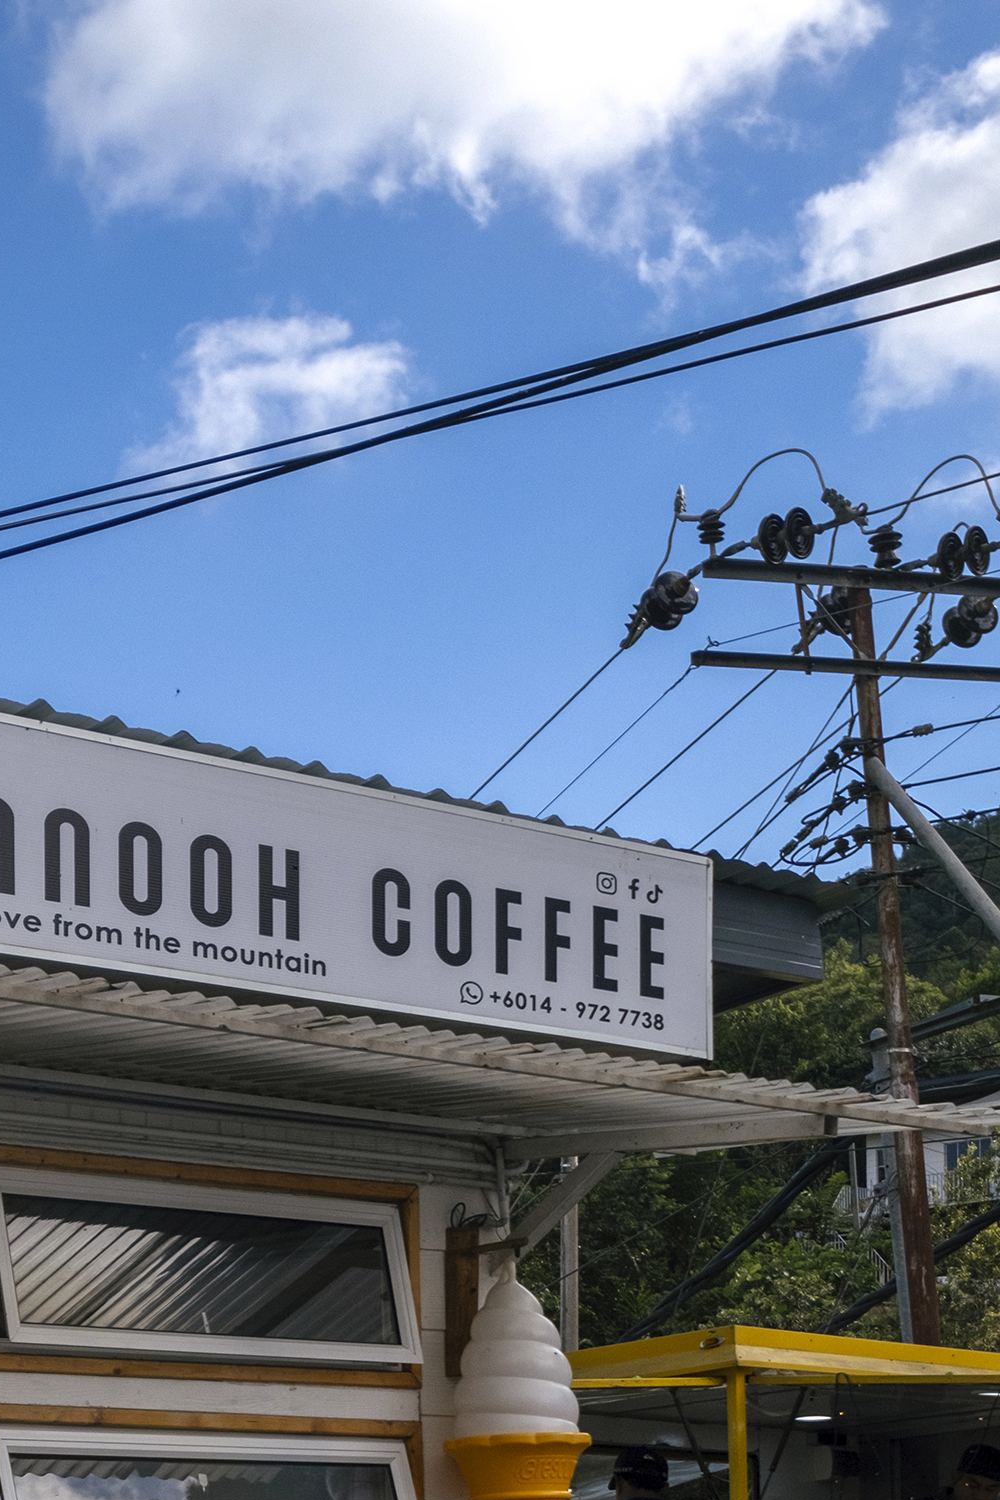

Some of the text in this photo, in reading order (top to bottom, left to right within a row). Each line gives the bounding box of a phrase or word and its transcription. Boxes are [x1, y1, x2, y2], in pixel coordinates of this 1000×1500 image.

[52, 913, 122, 945] from
[133, 926, 181, 954] the
[192, 939, 327, 977] mountain
[371, 867, 665, 1000] COFFEE
[489, 990, 552, 1015] +6014
[575, 1001, 611, 1023] 972
[618, 1008, 665, 1031] 7738
